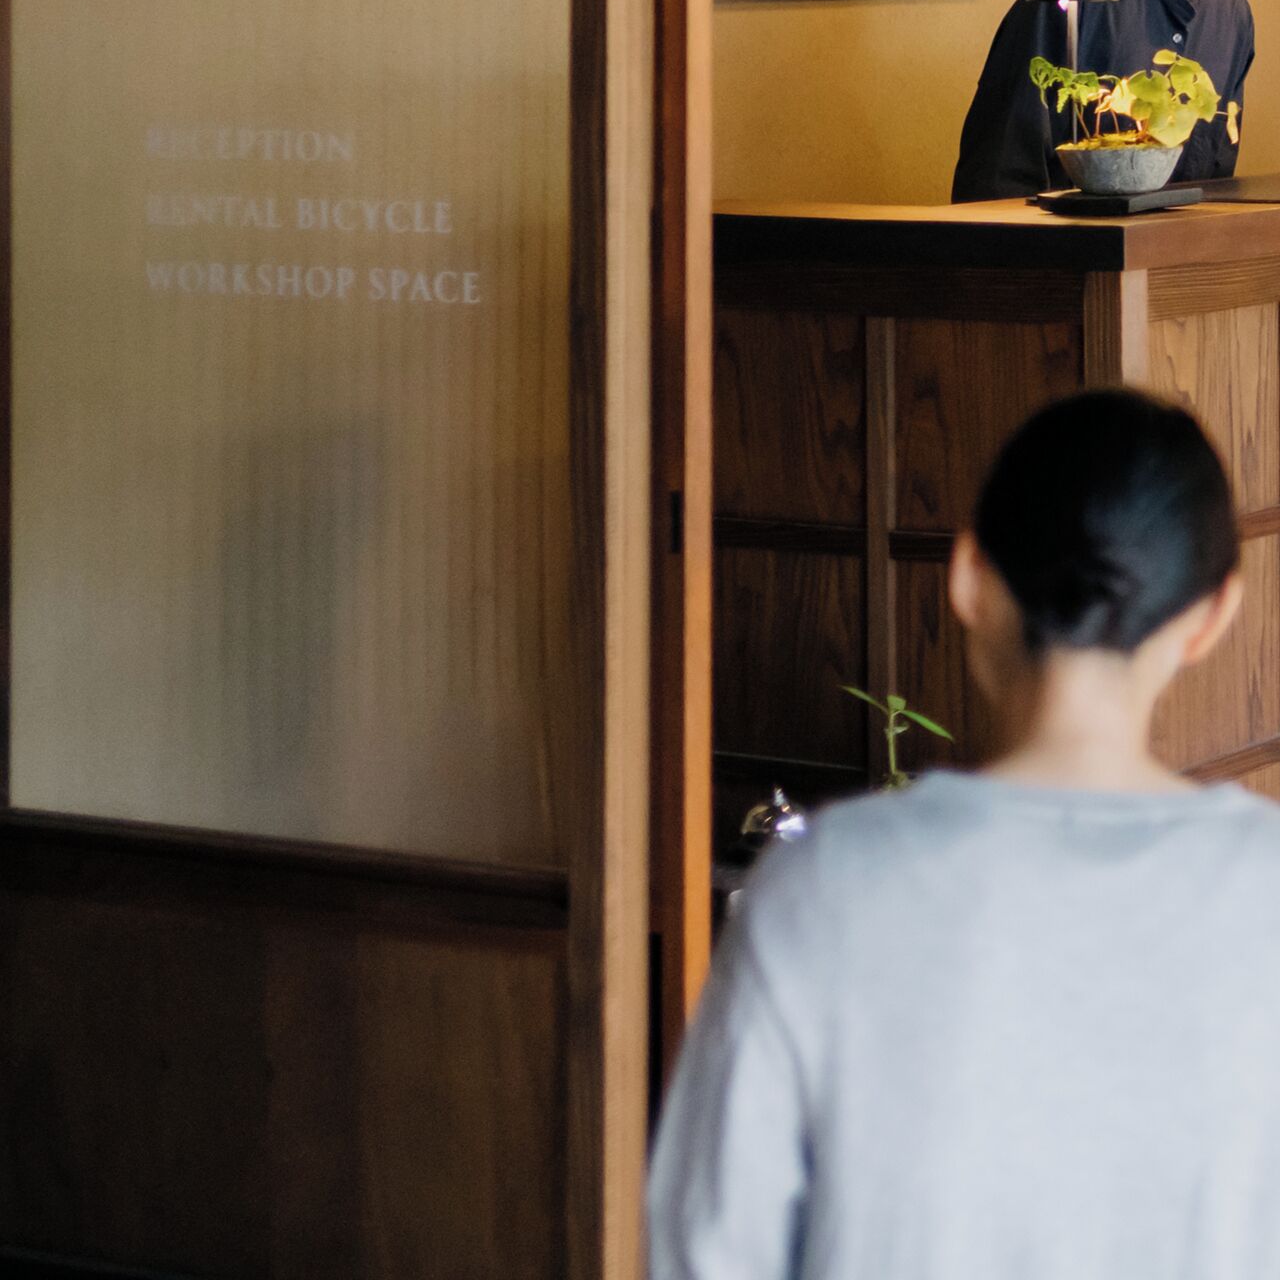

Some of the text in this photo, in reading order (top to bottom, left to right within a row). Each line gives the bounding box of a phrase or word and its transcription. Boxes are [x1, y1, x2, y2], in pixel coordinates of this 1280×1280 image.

[146, 128, 354, 161] RECEPTION
[146, 194, 453, 234] RENTAL BICYCLE
[145, 261, 482, 305] WORKSHOP SPACE
